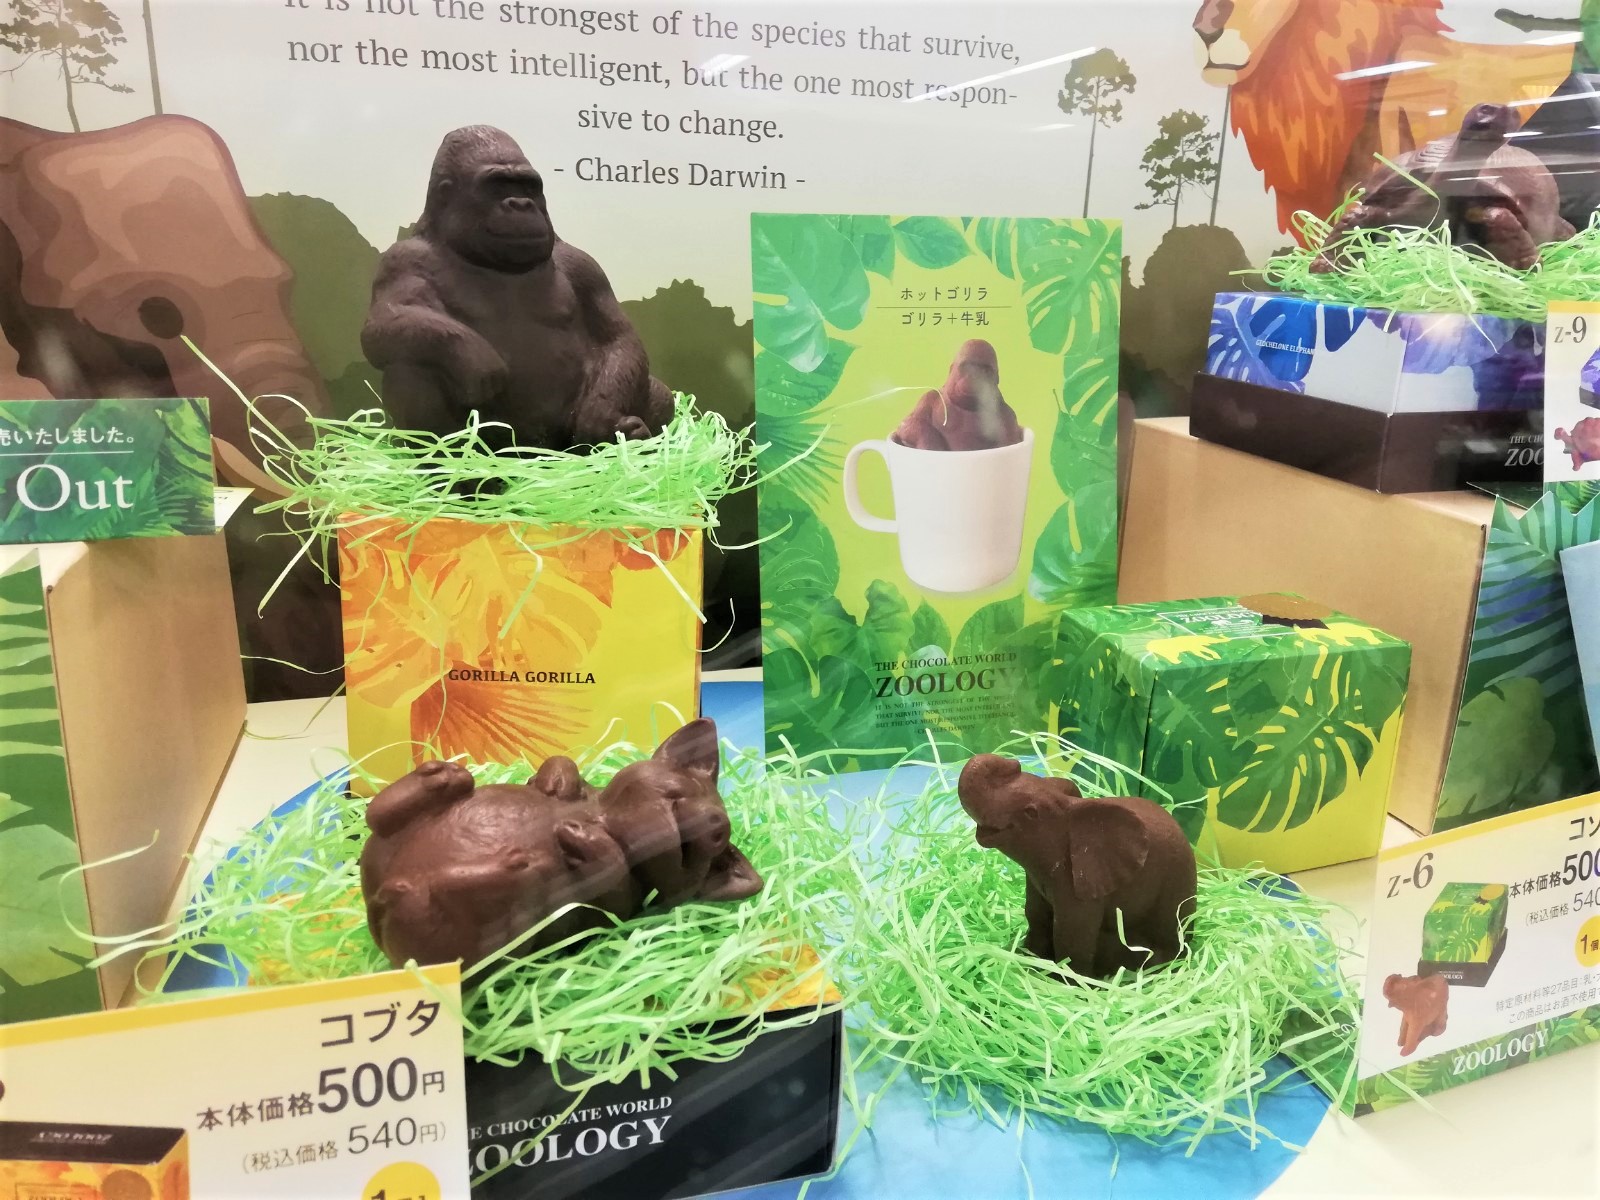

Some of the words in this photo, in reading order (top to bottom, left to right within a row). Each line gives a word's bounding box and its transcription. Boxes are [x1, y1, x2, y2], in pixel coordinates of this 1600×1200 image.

[433, 0, 484, 20] the
[499, 1, 639, 35] strongest
[652, 10, 683, 35] of
[692, 13, 739, 39] the
[751, 22, 846, 48] species
[858, 26, 912, 52] that
[923, 35, 1020, 65] survive,
[287, 41, 343, 63] nor
[355, 39, 408, 67] the
[421, 49, 498, 73] most
[510, 49, 671, 89] intelligent,
[682, 60, 728, 88] but
[738, 65, 783, 91] the
[793, 75, 841, 95] one
[851, 79, 915, 100] most
[924, 83, 1018, 108] respon-
[577, 104, 633, 130] sive
[641, 109, 670, 132] to
[679, 110, 784, 143] change.
[575, 157, 680, 185] Charles
[687, 163, 787, 190] Darwin
[901, 286, 988, 301] ホットゴリラ
[1510, 435, 1525, 444] THE
[16, 463, 134, 511] Out
[449, 669, 520, 683] GORILLA
[525, 671, 596, 685] GORILLA
[875, 661, 899, 672] THE
[902, 656, 972, 670] CHOCOLATE
[975, 652, 1017, 663] WORLD
[321, 1000, 440, 1048] コブタ
[1452, 1028, 1548, 1076] ZOOLOGY
[606, 1096, 672, 1117] WORLD
